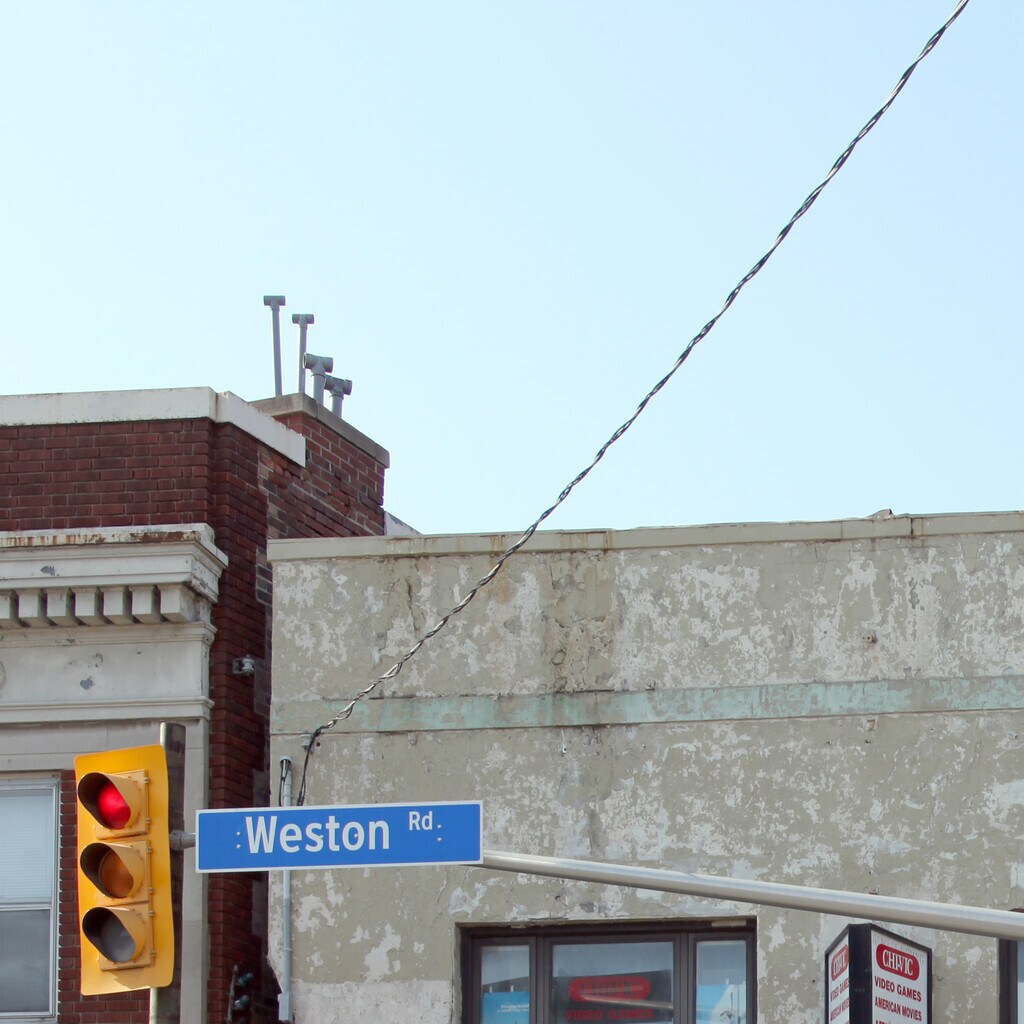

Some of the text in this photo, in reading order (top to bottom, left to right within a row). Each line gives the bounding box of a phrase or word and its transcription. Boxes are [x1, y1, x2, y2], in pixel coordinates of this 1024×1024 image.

[246, 811, 433, 853] Weston Rd
[875, 976, 922, 1002] VIDEO GAMES
[875, 996, 922, 1021] AMERICAN MOVIES
